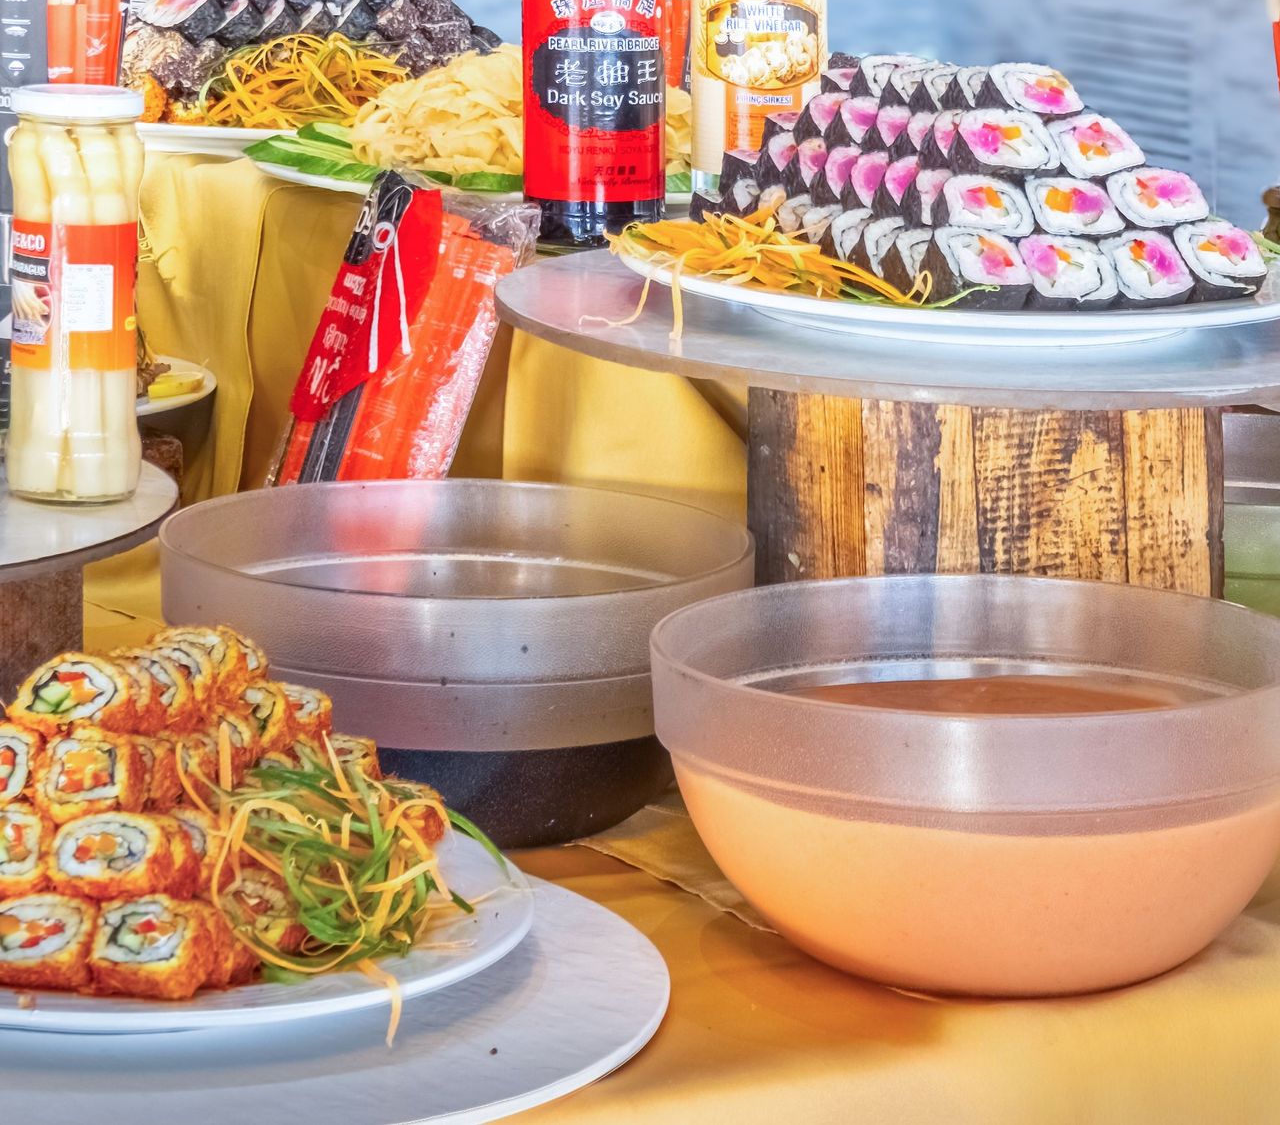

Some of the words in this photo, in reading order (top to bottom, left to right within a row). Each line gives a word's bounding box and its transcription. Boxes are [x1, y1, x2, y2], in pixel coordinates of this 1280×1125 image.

[754, 19, 801, 32] VINEGAR
[548, 37, 587, 51] PEARL
[588, 37, 624, 51] RIVER
[626, 37, 659, 50] BRIDGE
[554, 59, 658, 87] 老抽王
[547, 89, 586, 106] Dark
[590, 90, 625, 110] Soy
[628, 90, 663, 105] Sauce
